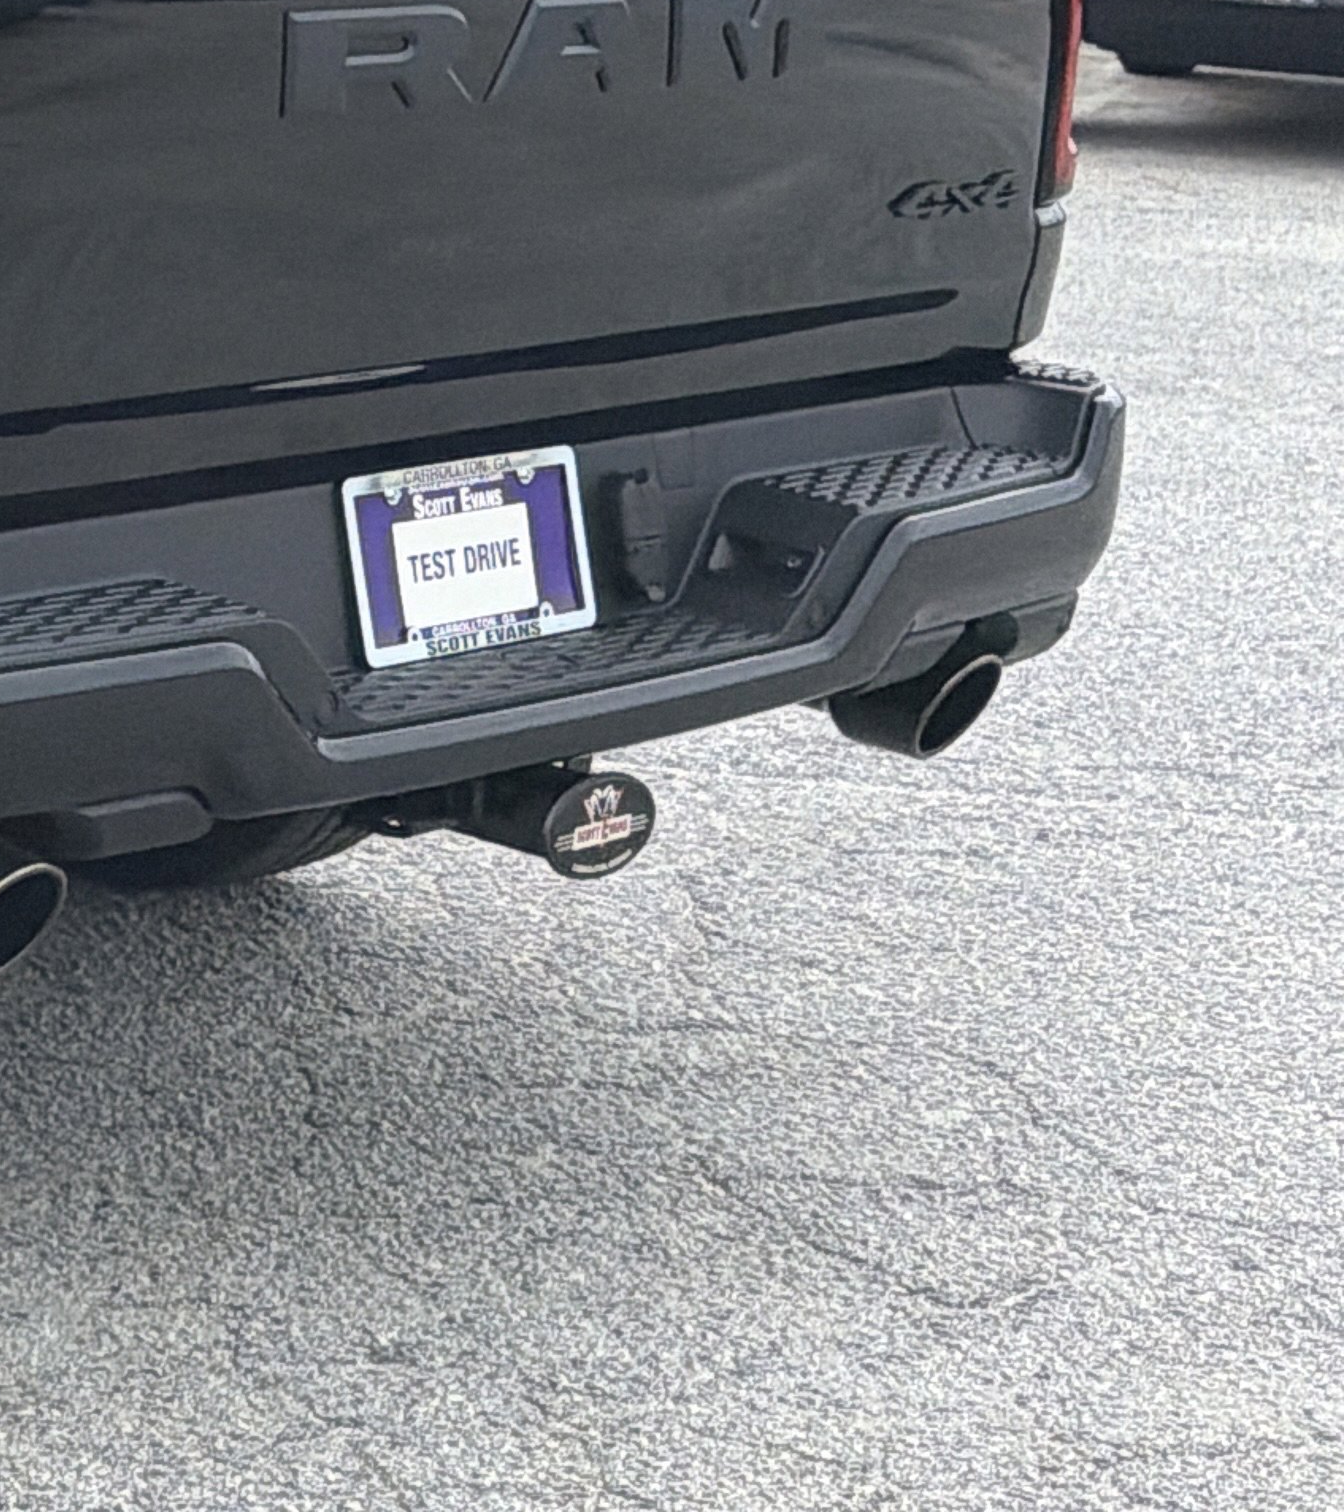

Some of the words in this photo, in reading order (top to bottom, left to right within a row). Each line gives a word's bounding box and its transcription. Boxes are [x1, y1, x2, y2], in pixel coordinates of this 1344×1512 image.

[493, 456, 512, 469] GA
[407, 548, 456, 584] TEST
[464, 538, 522, 574] DRIVE
[426, 631, 479, 656] SCOTT
[485, 621, 542, 643] EVANS
